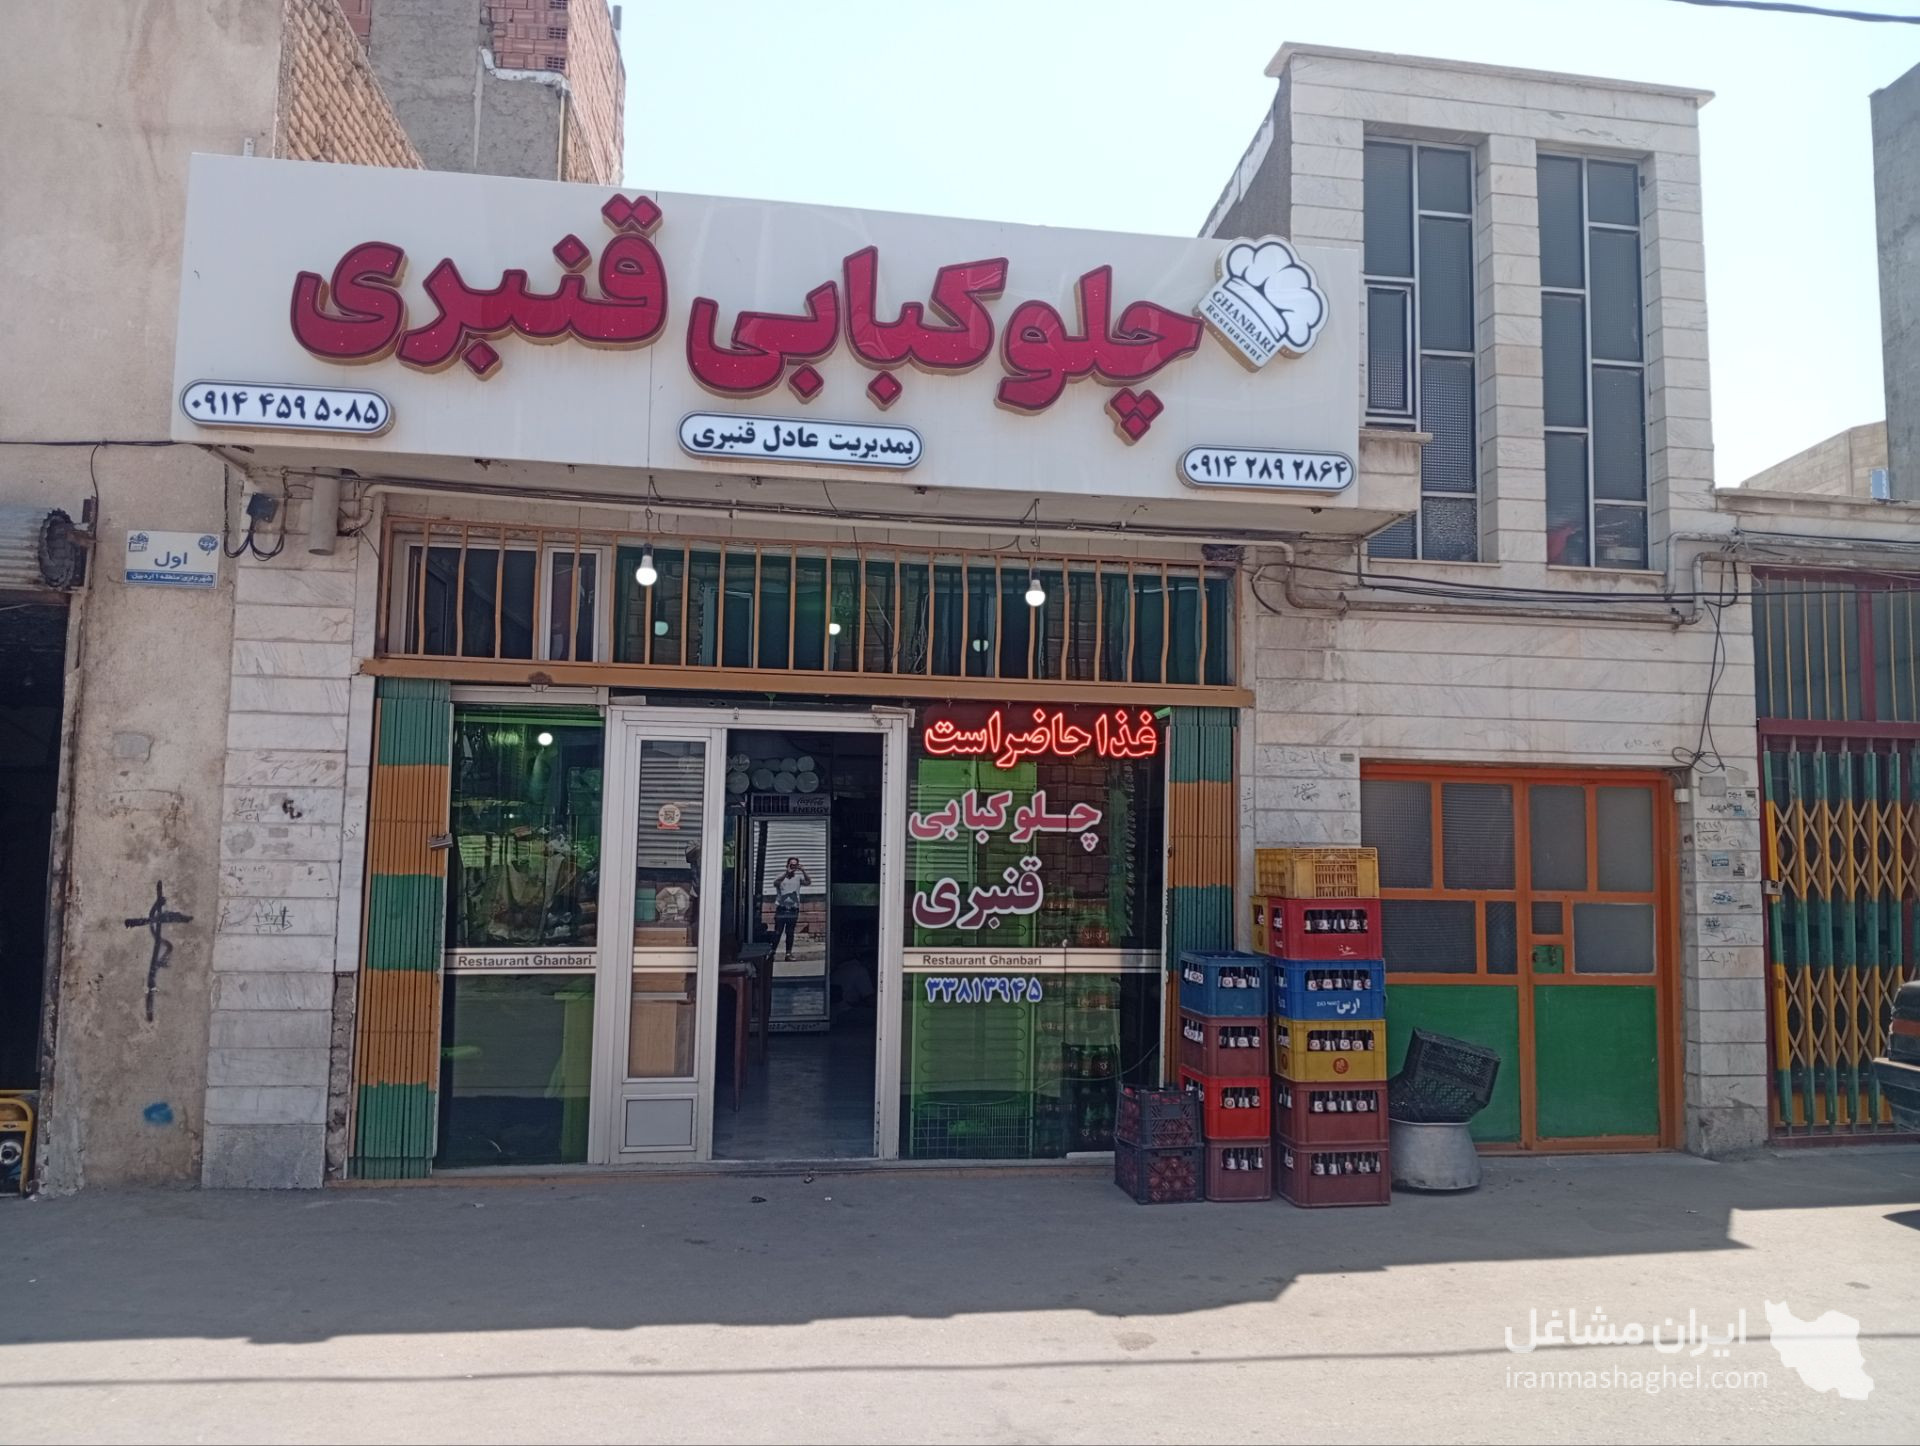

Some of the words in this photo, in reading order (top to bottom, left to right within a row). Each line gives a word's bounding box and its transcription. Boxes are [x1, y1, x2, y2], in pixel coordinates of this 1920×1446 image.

[290, 193, 668, 378] قنبری
[1206, 304, 1263, 361] Restuarant
[1212, 291, 1276, 354] GHANBARI
[191, 391, 248, 416] ۰۹۱۴
[258, 393, 306, 419] ۴۵۹
[314, 397, 379, 424] ۵۰۸۵
[692, 421, 756, 450] قنبری
[763, 424, 819, 452] عادل
[828, 432, 914, 460] بمدیریت
[1190, 454, 1237, 478] ۰۹۱۴
[1245, 457, 1284, 480] ۲۸۹
[1292, 459, 1348, 483] ۲۸۶۴
[154, 551, 188, 569] اول
[925, 711, 1001, 754] است
[996, 708, 1092, 767] حاضر
[1095, 709, 1157, 757] غذا
[912, 856, 1044, 929] قنبری
[458, 955, 529, 967] Restaurant
[533, 954, 593, 967] Ghanbari
[923, 954, 986, 965] Restaurant
[989, 954, 1042, 966] Ghanbari
[925, 977, 1042, 1003] ۳۳۸۱۳۹۴۵
